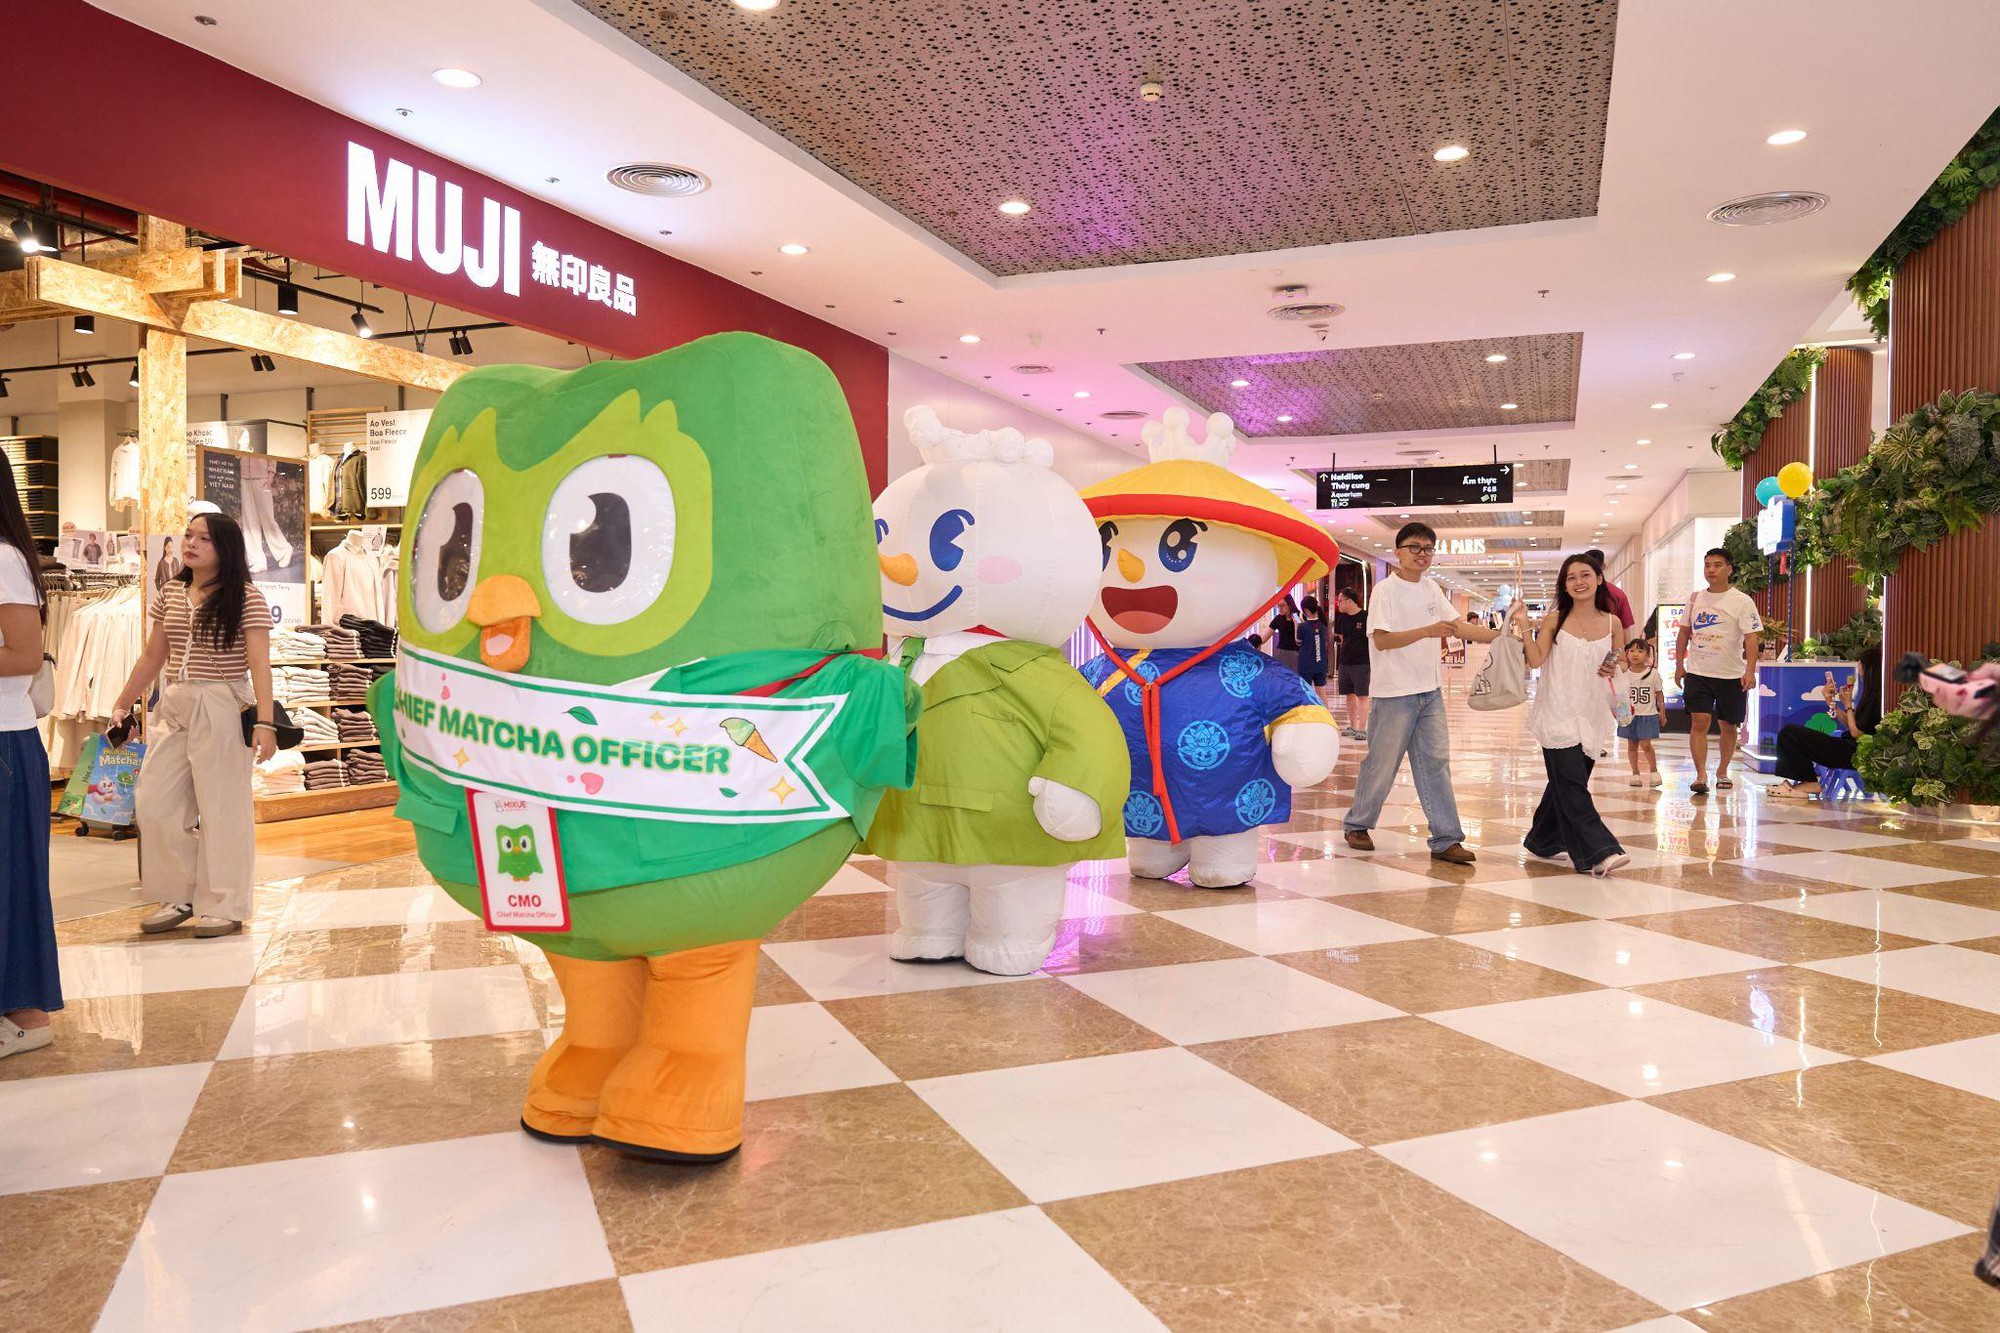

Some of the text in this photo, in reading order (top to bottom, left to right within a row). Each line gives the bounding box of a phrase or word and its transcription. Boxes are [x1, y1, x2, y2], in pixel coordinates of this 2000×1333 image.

[347, 140, 521, 298] MUJI
[531, 240, 638, 317] 無印良品
[381, 419, 396, 427] Vest
[370, 428, 407, 437] Boa Fleece
[1351, 482, 1370, 490] cung
[371, 488, 392, 500] 599
[1330, 491, 1363, 499] Aquarium
[1450, 538, 1486, 555] PARIS
[438, 705, 566, 760] MATCHA
[572, 733, 731, 775] OFFICER
[508, 894, 542, 907] CMO
